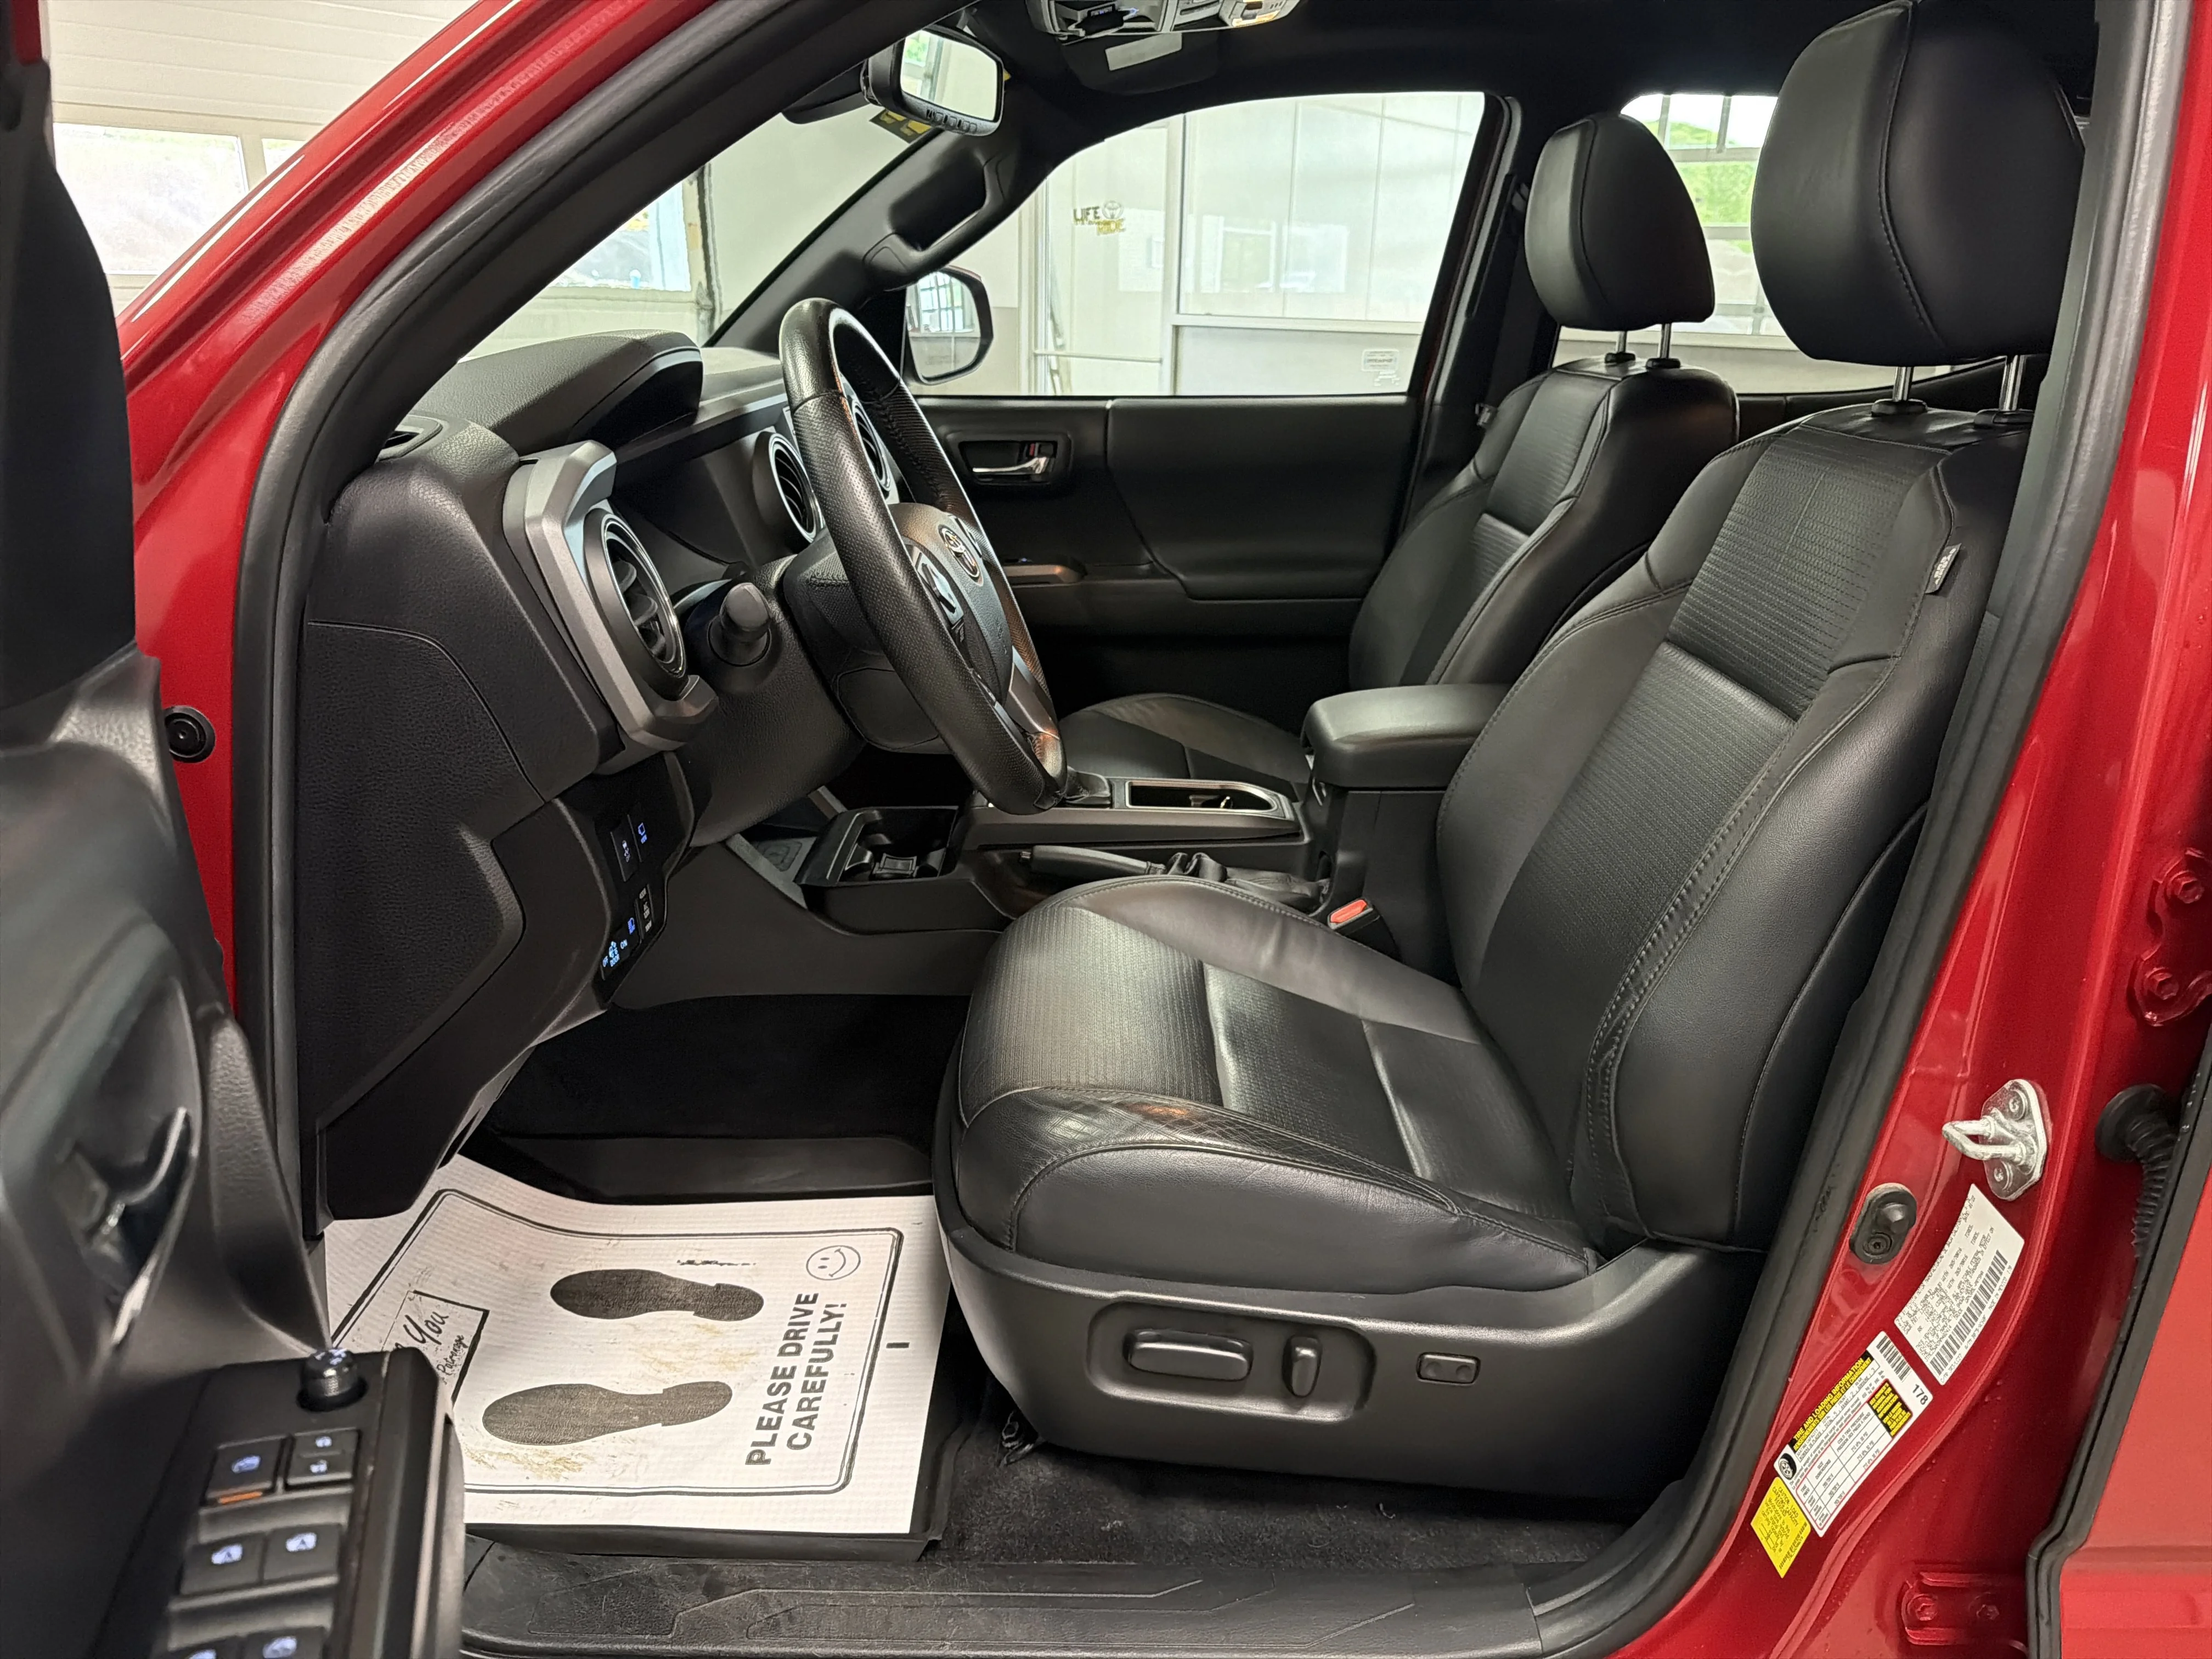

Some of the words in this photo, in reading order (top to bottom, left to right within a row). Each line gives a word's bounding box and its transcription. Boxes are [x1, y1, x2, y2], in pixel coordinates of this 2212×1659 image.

[620, 939, 628, 950] ON
[403, 1311, 450, 1345] You
[745, 1365, 797, 1465] PLEASE
[777, 1293, 819, 1357] DRIVE
[786, 1303, 847, 1451] CAREFULLY!
[1840, 1386, 1846, 1394] ET
[1793, 1426, 1805, 1442] TIRE
[1802, 1415, 1814, 1430] AND
[1812, 1392, 1833, 1418] LOADING
[1831, 1357, 1864, 1396] INFORMATION
[1912, 1384, 1928, 1405] 178
